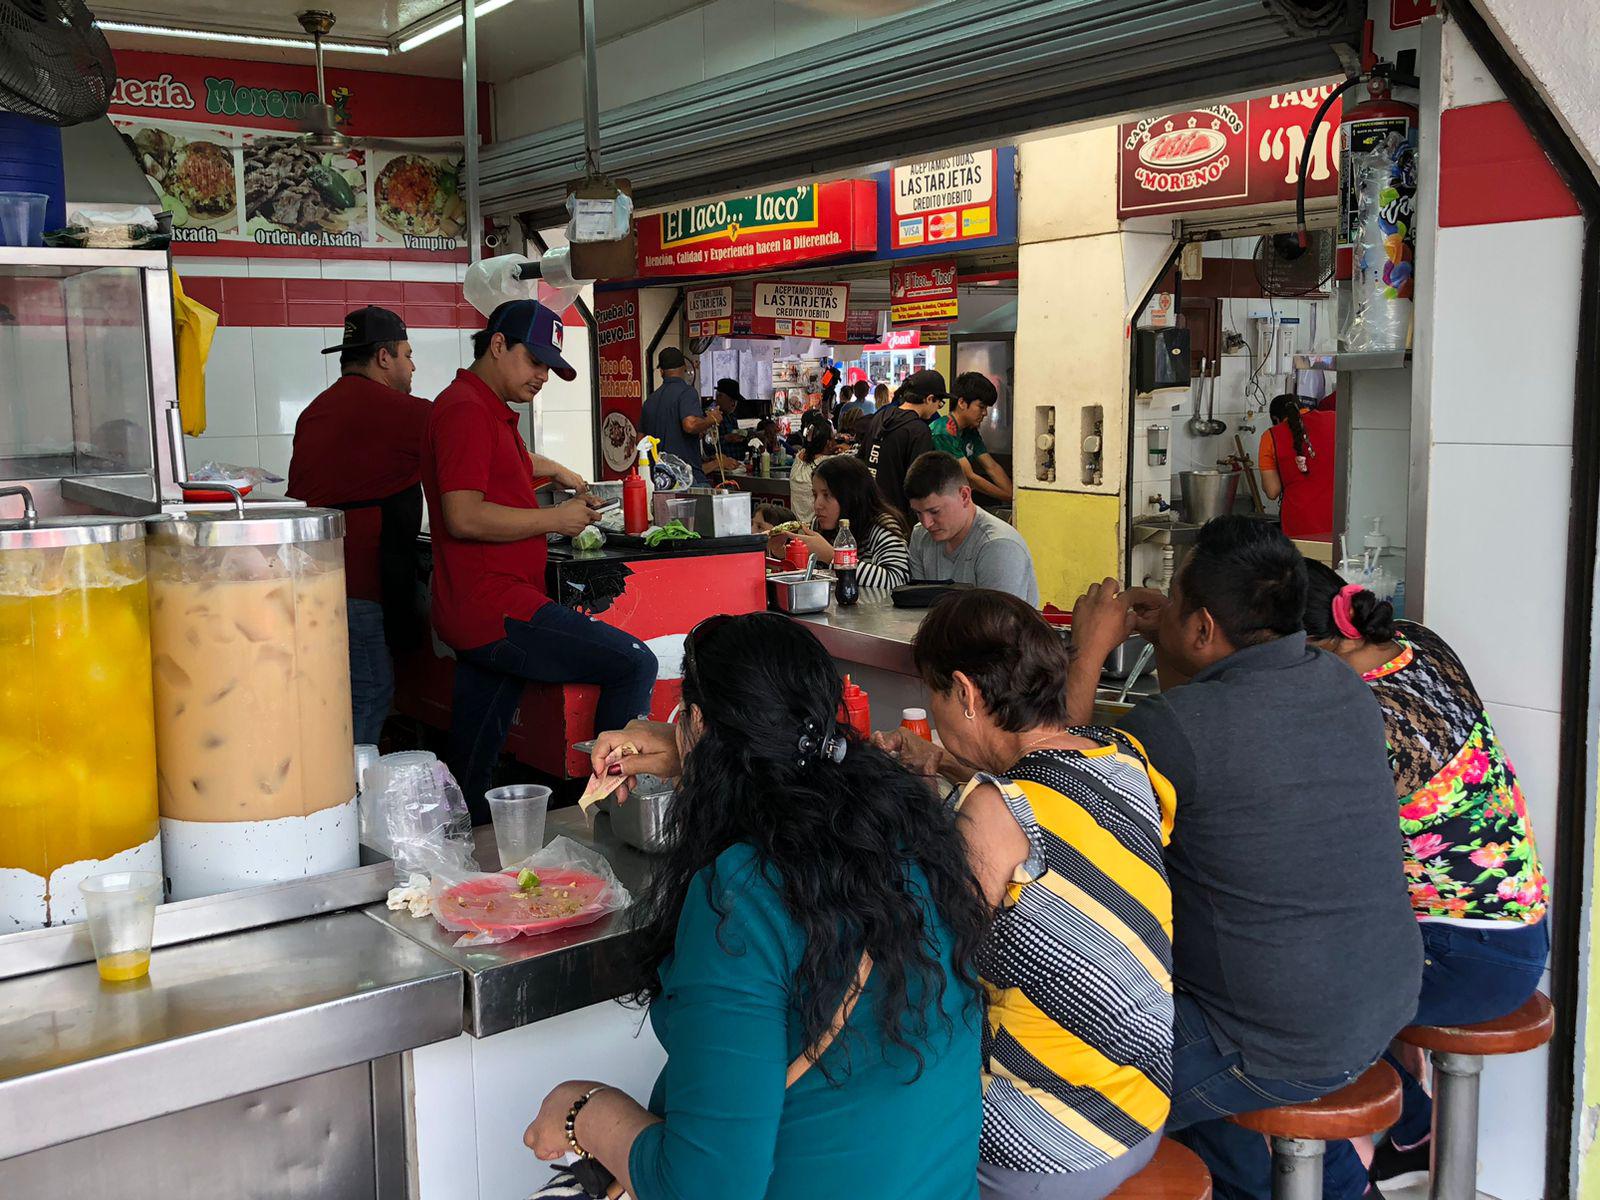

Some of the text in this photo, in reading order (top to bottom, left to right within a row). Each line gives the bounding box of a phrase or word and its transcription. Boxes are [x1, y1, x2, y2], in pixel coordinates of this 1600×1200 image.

[109, 74, 194, 109] uería
[901, 165, 982, 197] LAS TARJETAS
[170, 226, 456, 250] iscada Orden de Asada Vampiro
[676, 250, 702, 263] Calidad
[711, 243, 754, 261] Experiencia
[756, 240, 781, 254] hacen
[782, 236, 792, 250] la
[763, 295, 838, 309] LAS TARJETAS
[774, 285, 833, 296] ACEPTAMOS TODAS
[776, 308, 803, 317] CREDITO
[808, 310, 829, 318] DEBITO
